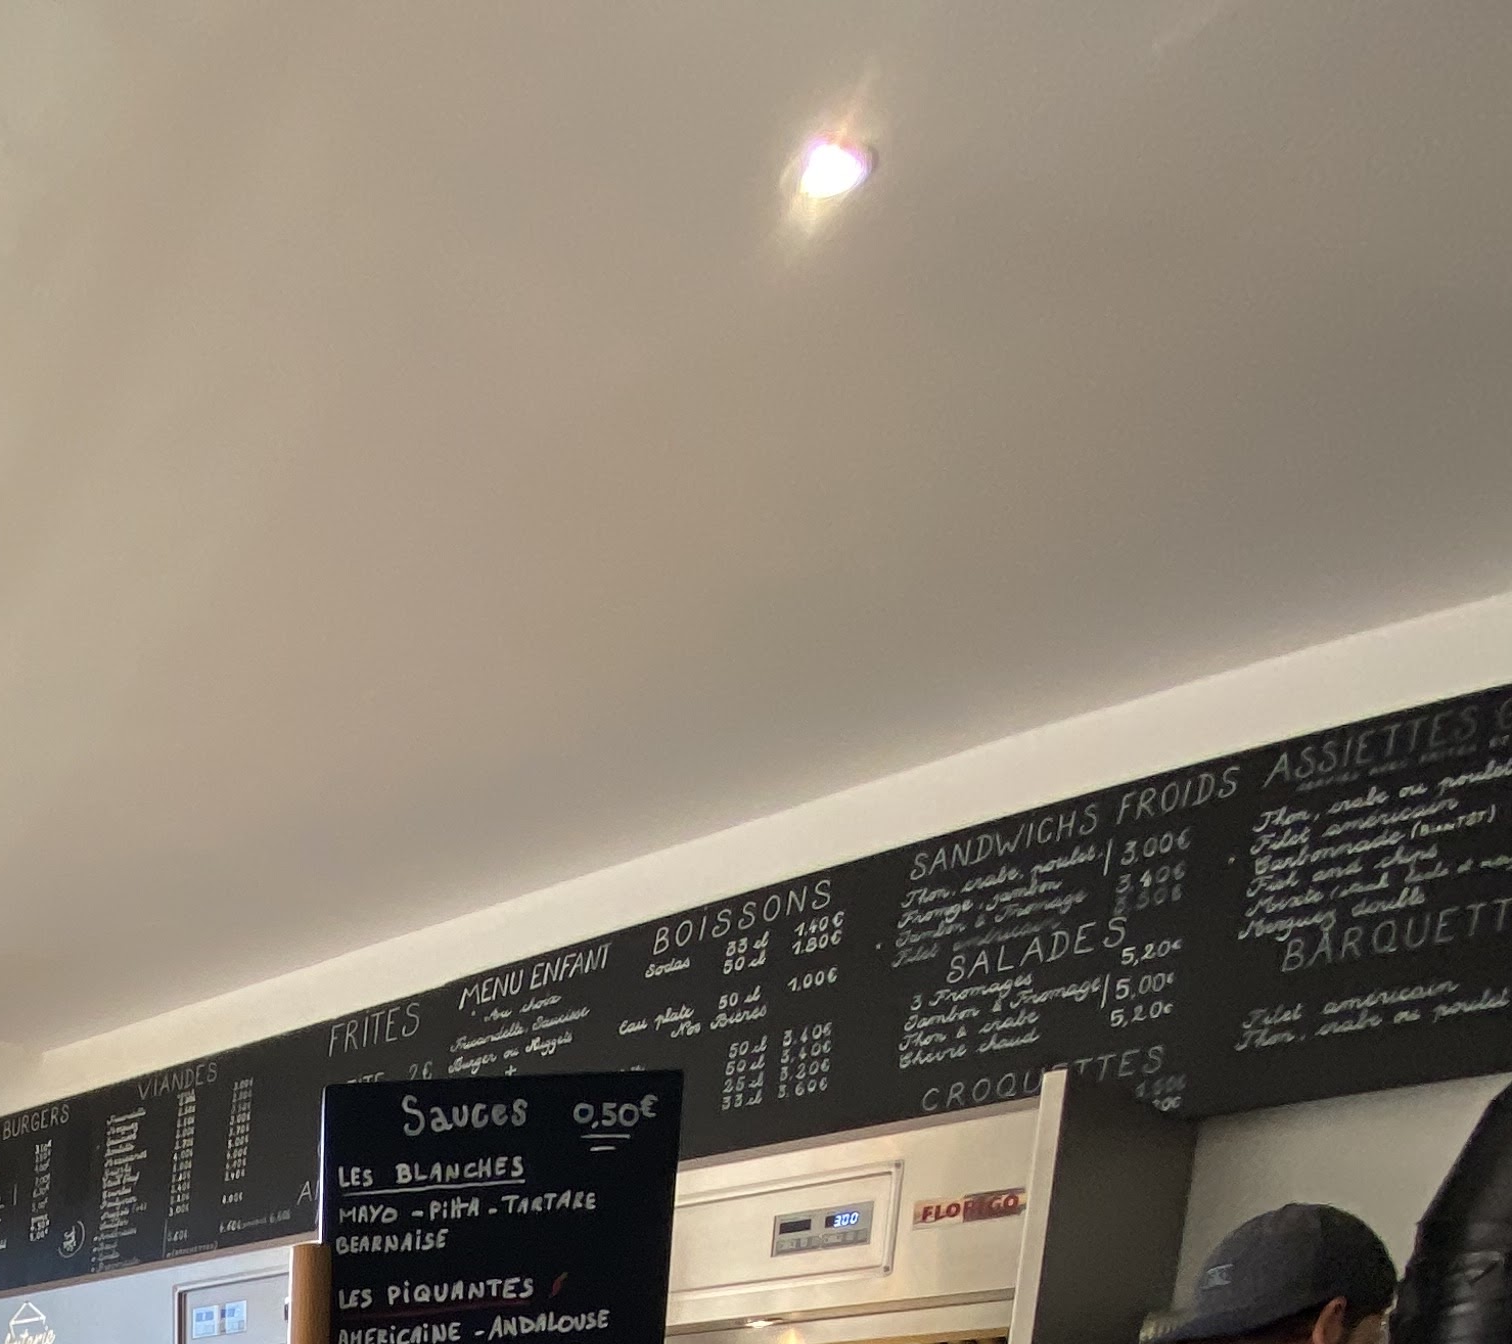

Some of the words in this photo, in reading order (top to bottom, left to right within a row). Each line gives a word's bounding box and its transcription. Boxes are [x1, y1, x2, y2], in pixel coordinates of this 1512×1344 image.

[909, 803, 1099, 880] SANDWICHS
[1116, 766, 1241, 825] FROIDS
[652, 879, 832, 956] BOISSONS
[645, 956, 691, 978] Sodas
[946, 916, 1128, 984] SALADES
[457, 968, 525, 1011] MENU
[529, 942, 613, 991] ENFANT
[718, 992, 739, 1010] 50
[327, 1001, 421, 1058] FRITES
[138, 1061, 219, 1100] VIANDES
[922, 1045, 1165, 1113] CROQUTTES
[2, 1103, 71, 1141] BURGERS
[402, 1095, 528, 1136] Sauces
[573, 1094, 659, 1129] 0,50€
[338, 1165, 374, 1188] LES
[395, 1155, 525, 1184] BLANCHES
[339, 1204, 399, 1224] MAYO
[501, 1188, 597, 1215] TARTARE
[338, 1287, 373, 1310] LES
[488, 1309, 611, 1342] ANDALOUSE
